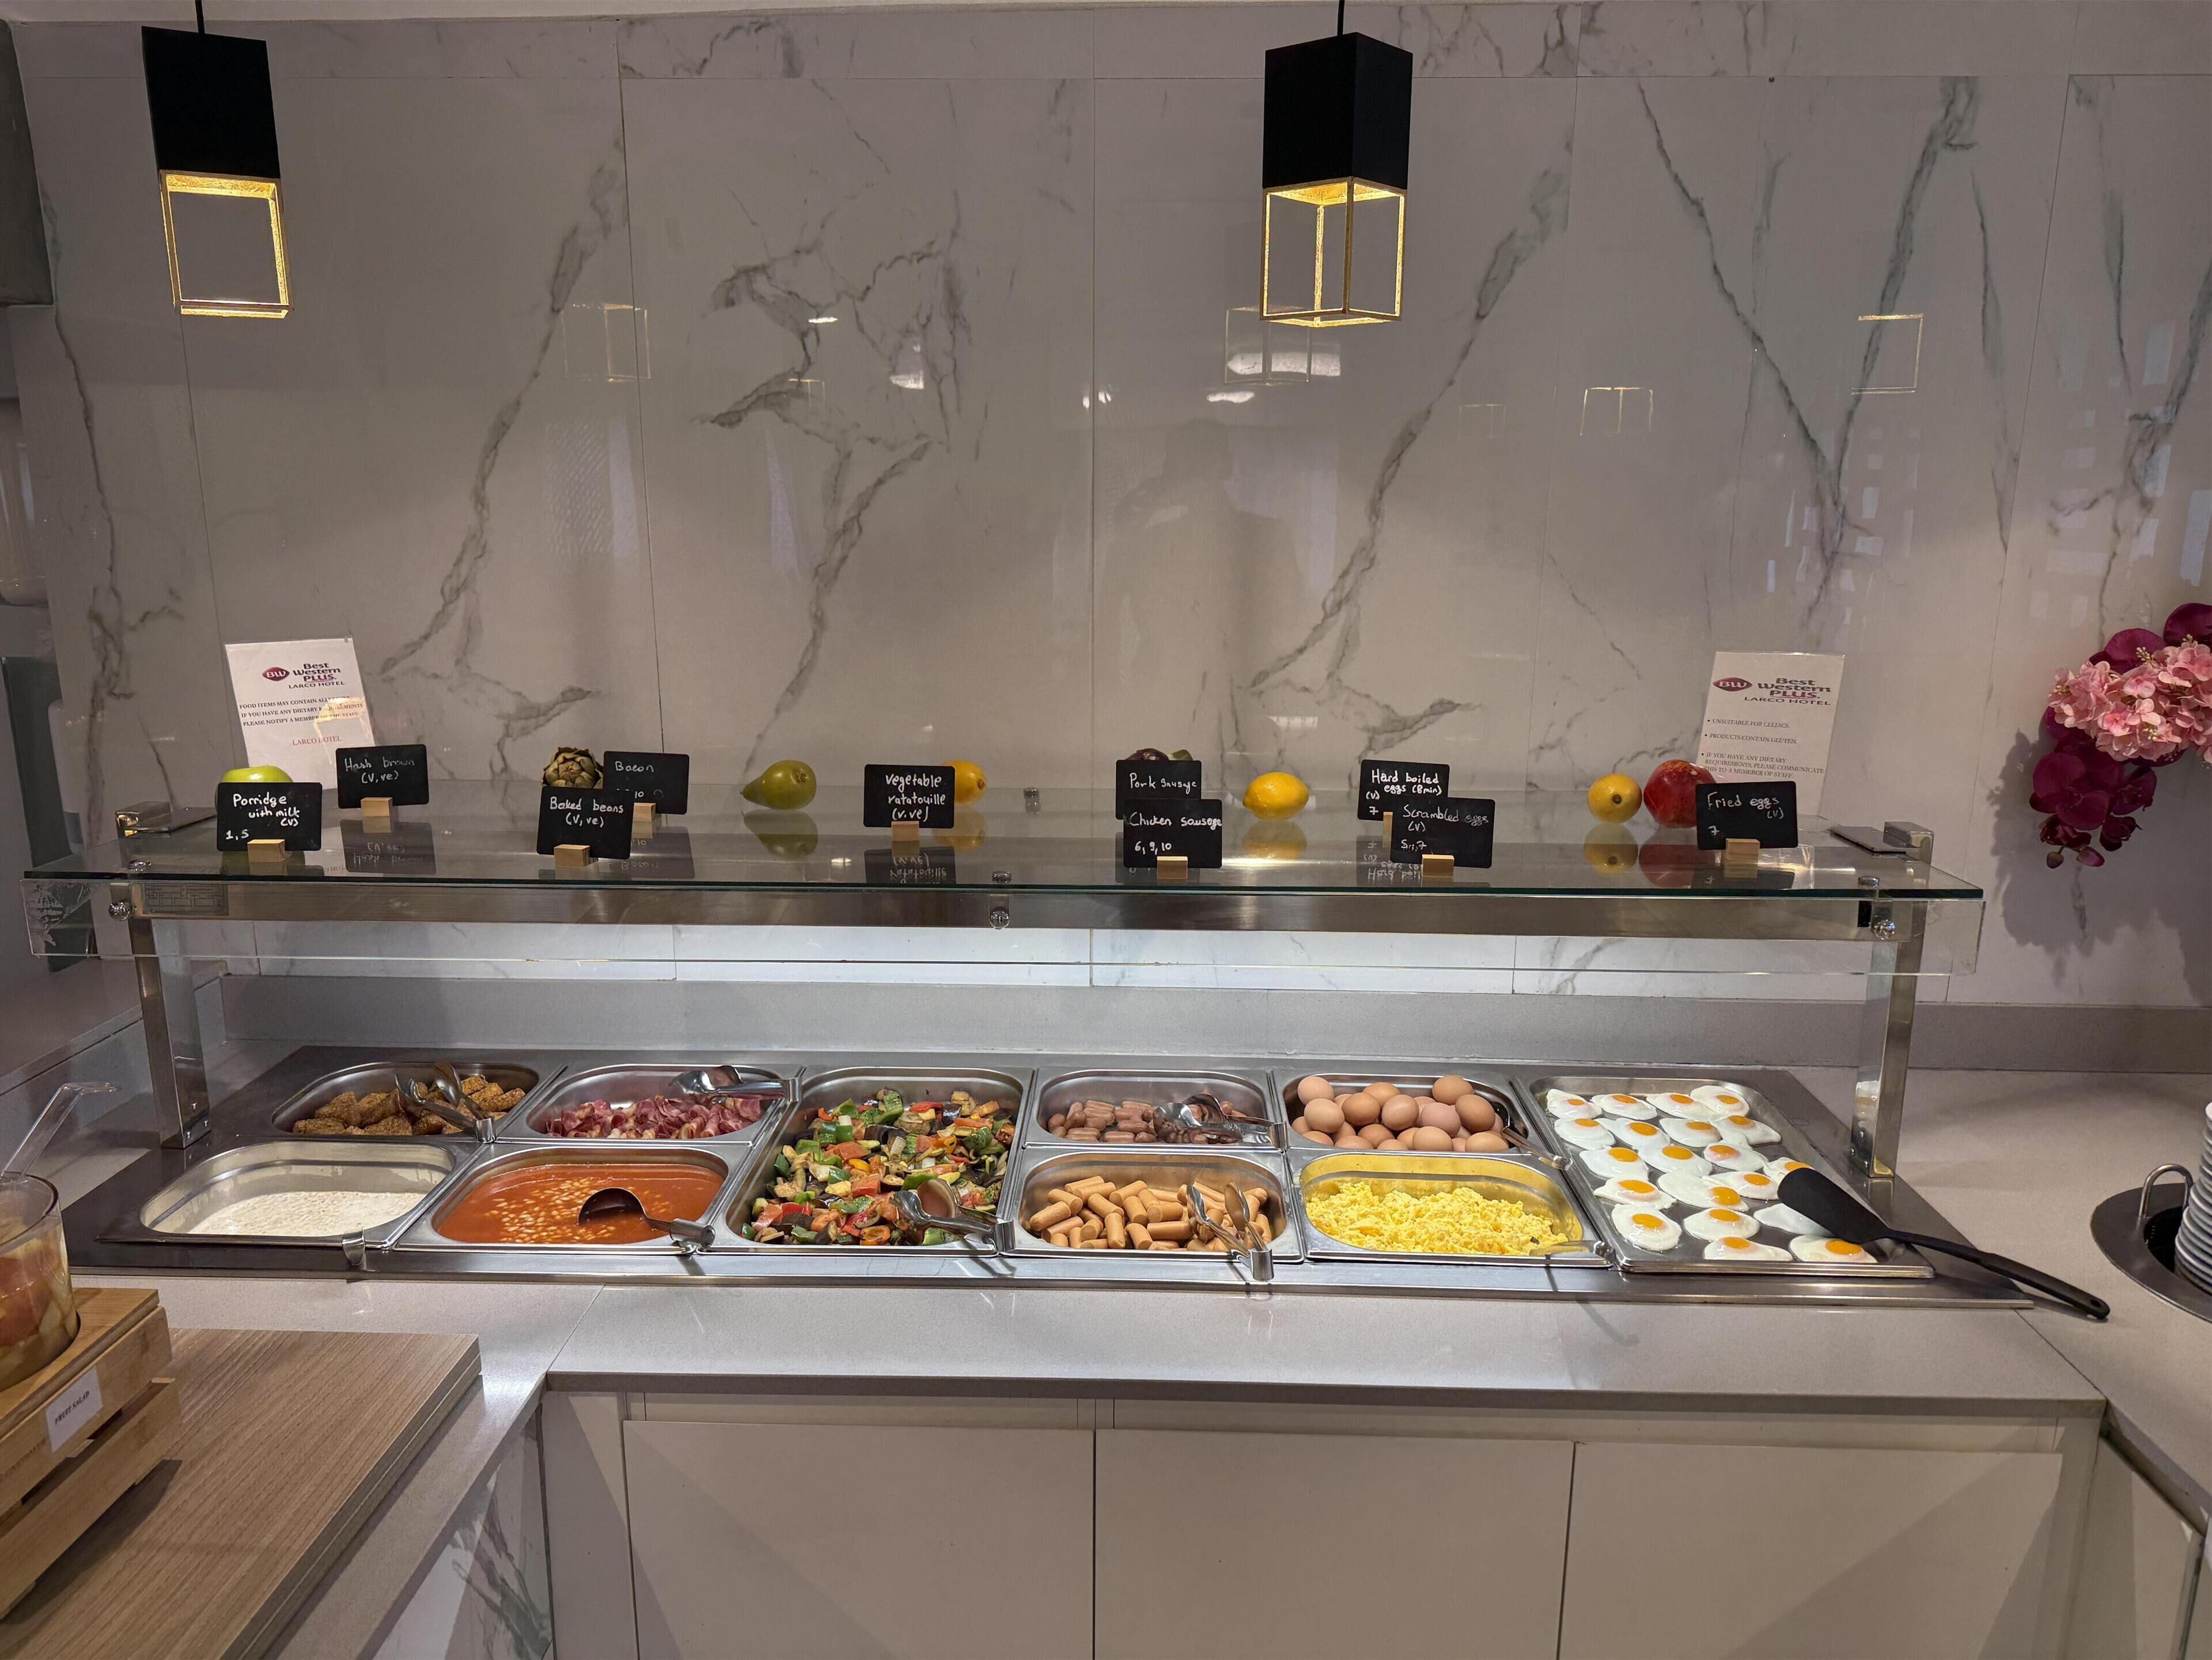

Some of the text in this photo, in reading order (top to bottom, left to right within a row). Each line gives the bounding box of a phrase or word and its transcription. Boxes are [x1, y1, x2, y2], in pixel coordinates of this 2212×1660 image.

[1758, 683, 1831, 692] Western
[292, 737, 317, 746] LARCO
[345, 757, 372, 772] Hash
[615, 761, 654, 772] Bacon
[1777, 765, 1825, 774] COMMUNICATE
[1372, 768, 1440, 784] Hard boiled
[1733, 768, 1763, 776] MEMEBER
[1130, 772, 1156, 789] Pork
[1384, 784, 1406, 794] eggs
[233, 791, 287, 808] Porridge
[550, 796, 623, 813] Baked beans
[888, 793, 946, 805] ratatouille
[1707, 791, 1780, 810] Fried eggs
[248, 806, 300, 818] with milk
[1403, 804, 1488, 826] Scrambled eggs
[1129, 812, 1172, 827] Chicken
[1709, 825, 1719, 835] 7
[55, 1390, 90, 1425] FRUIT SALAD
